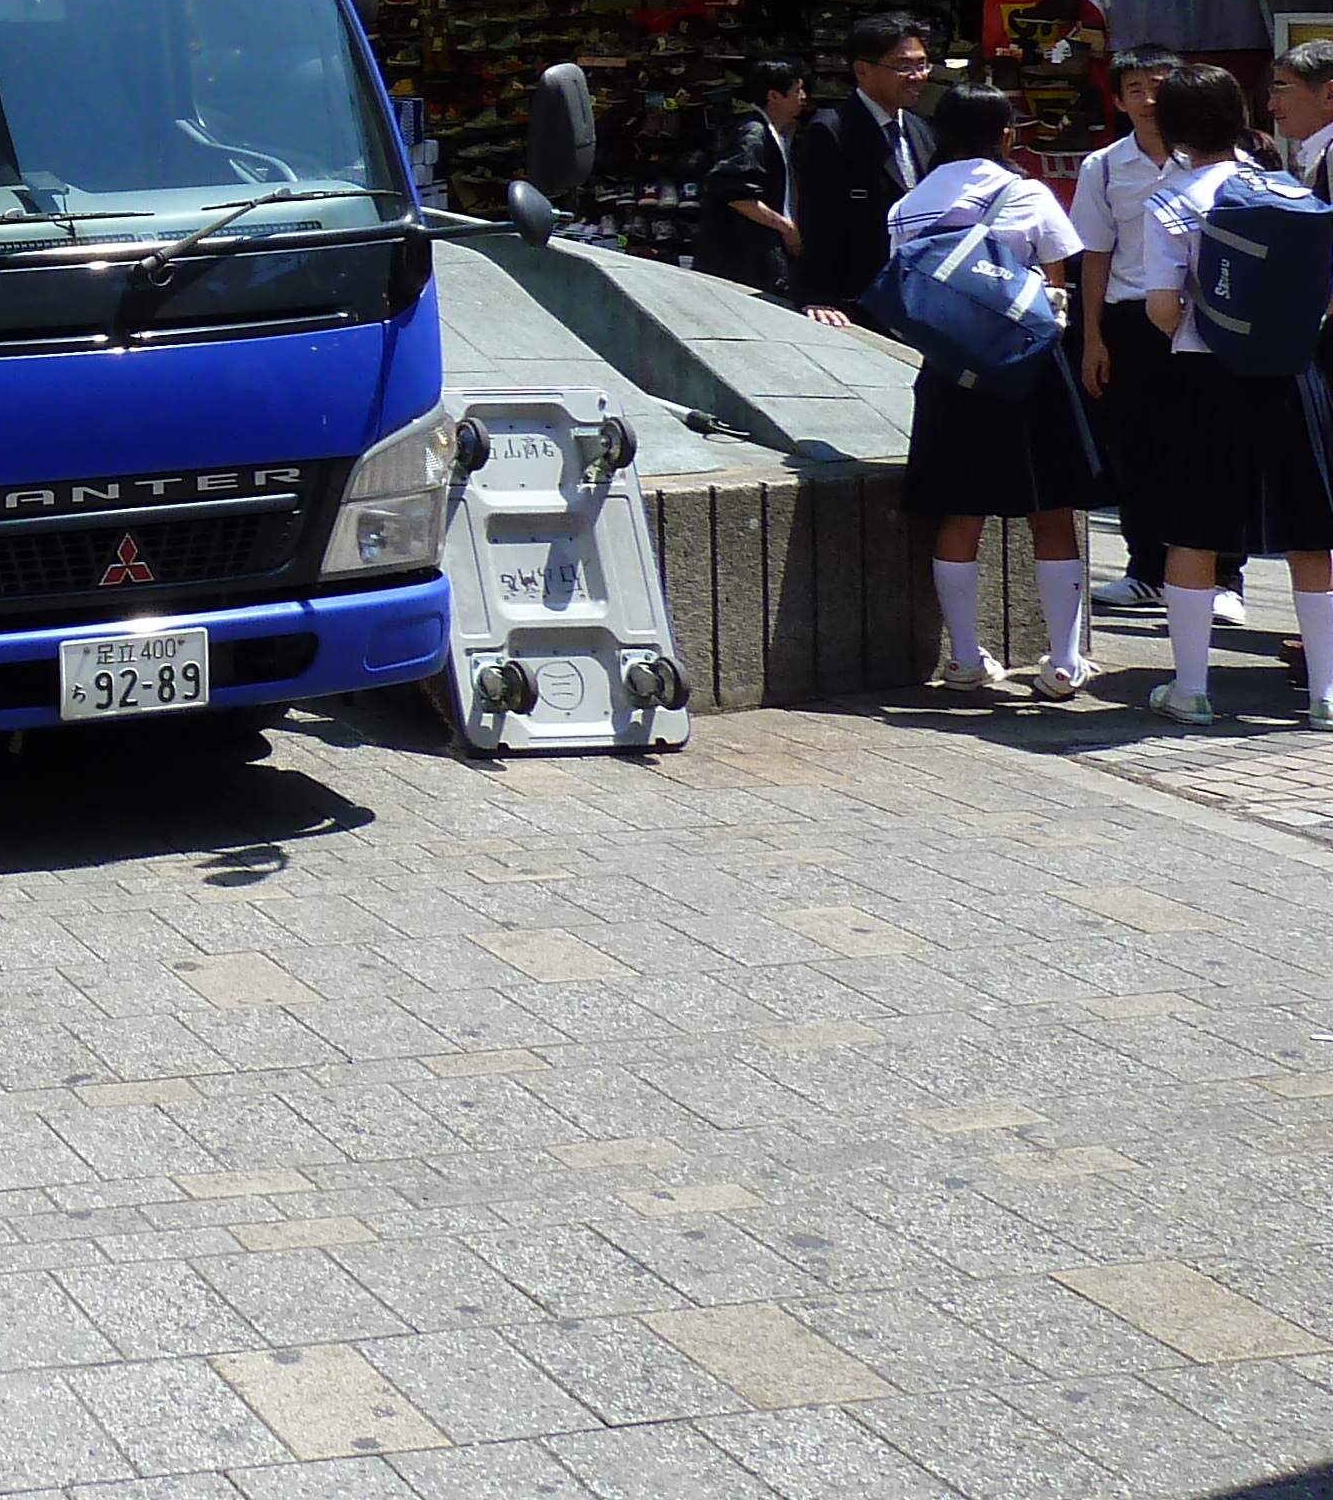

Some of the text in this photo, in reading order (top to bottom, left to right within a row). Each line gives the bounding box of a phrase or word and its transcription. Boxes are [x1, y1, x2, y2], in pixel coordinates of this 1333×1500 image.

[97, 638, 176, 665] 足立 400
[71, 662, 201, 710] ち 92-89
